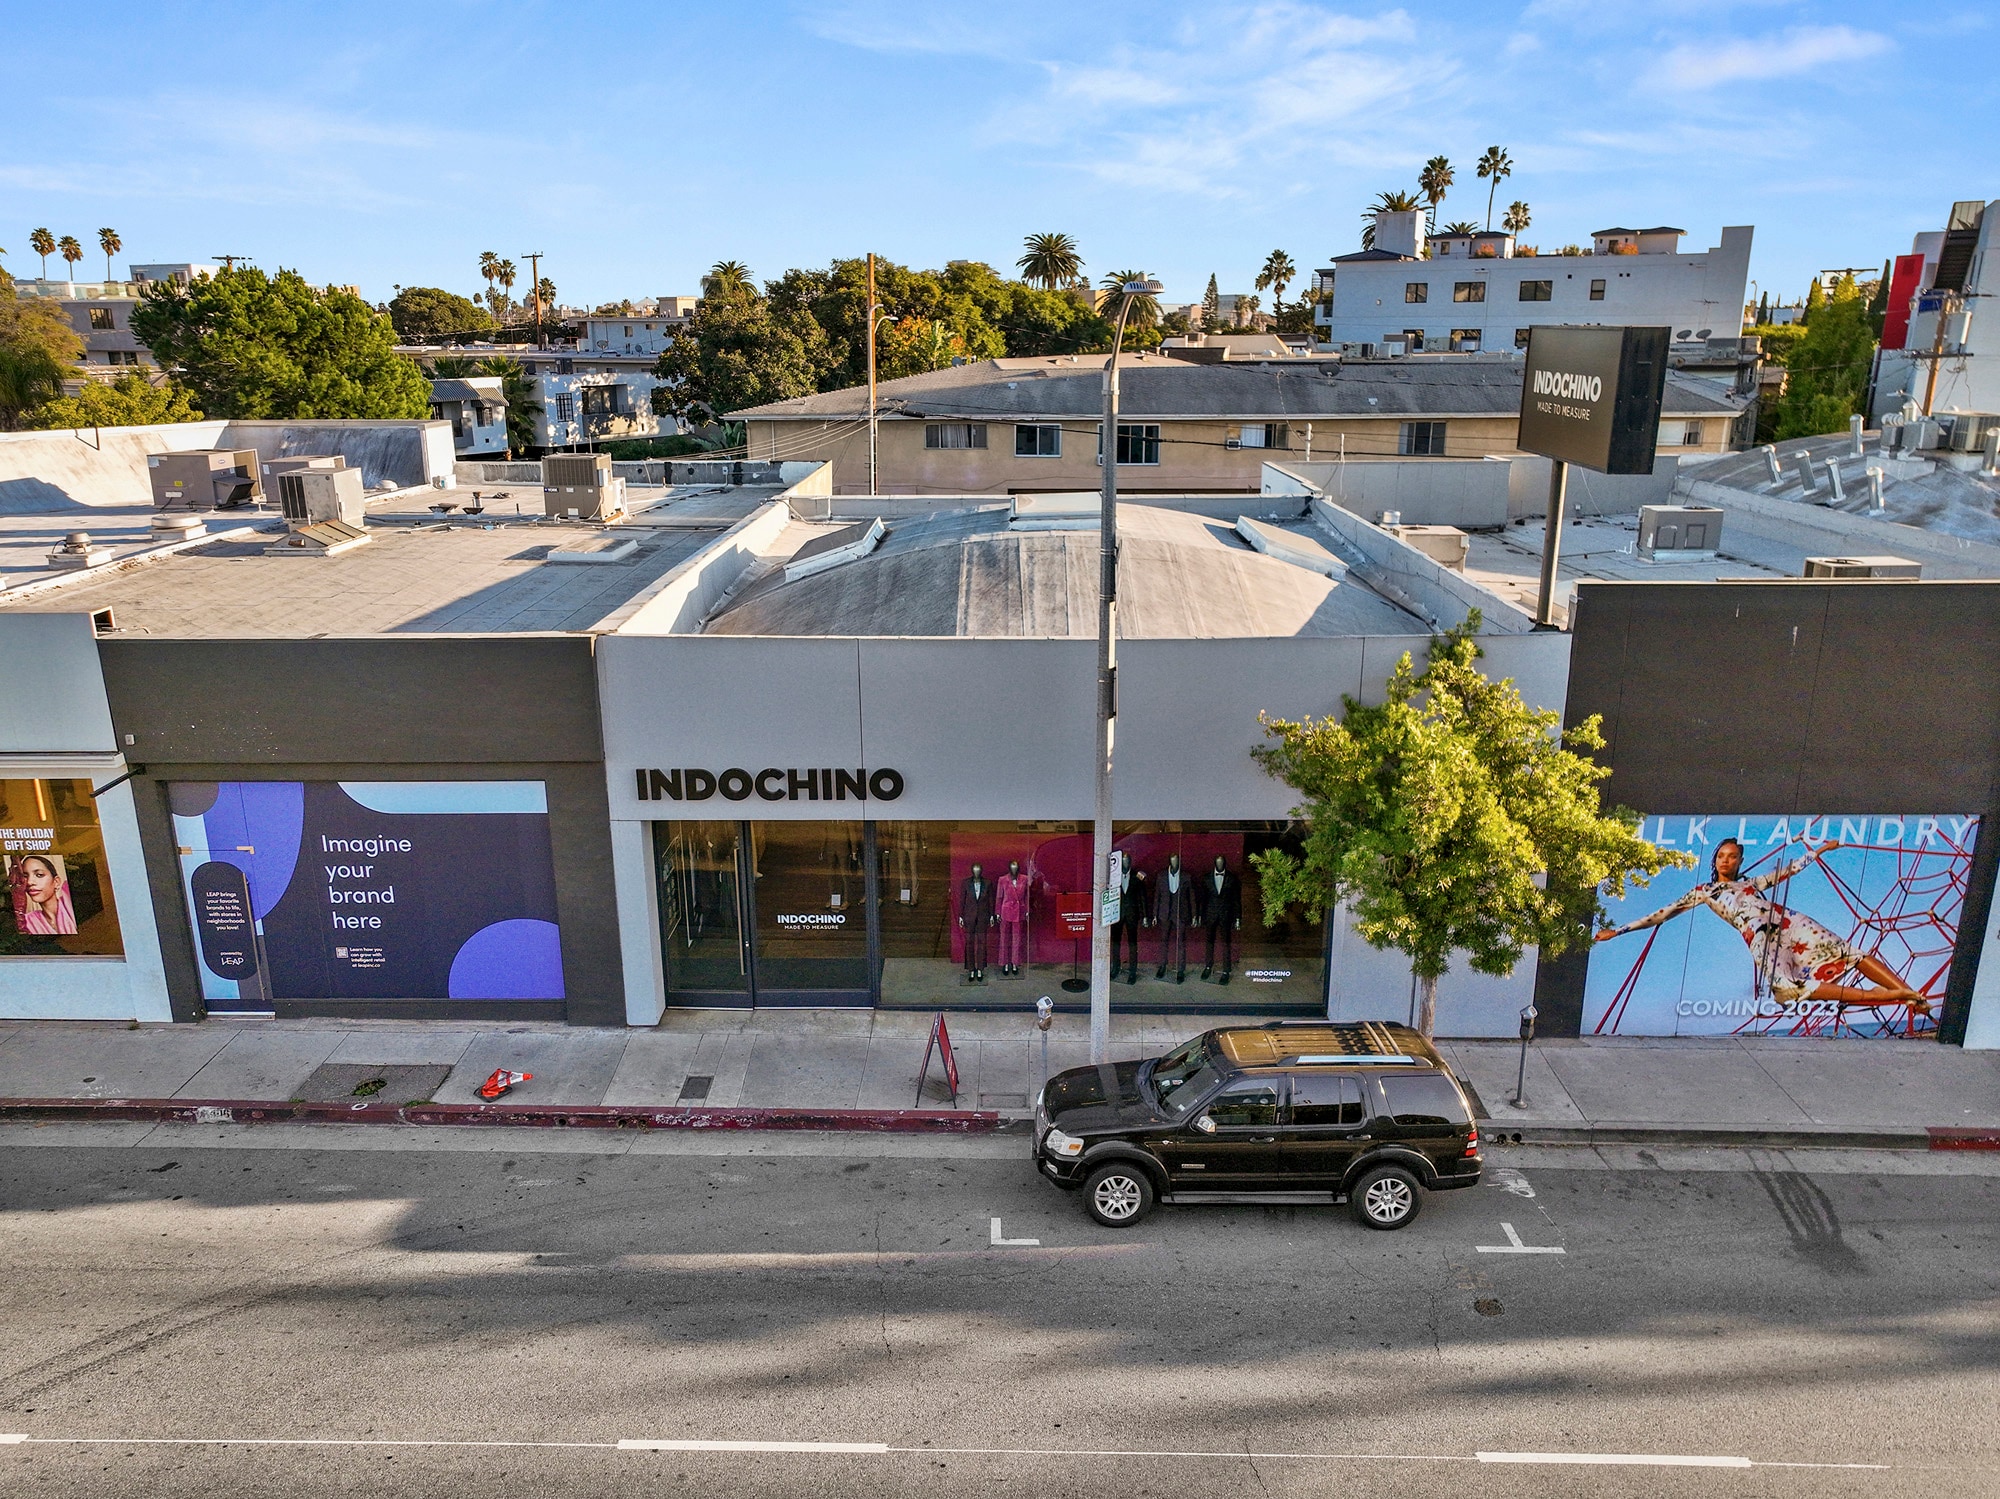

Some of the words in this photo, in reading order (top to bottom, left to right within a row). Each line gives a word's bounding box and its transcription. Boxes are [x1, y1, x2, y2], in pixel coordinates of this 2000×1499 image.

[1534, 370, 1602, 402] INDOCHINO
[1537, 401, 1552, 413] MADE
[1554, 403, 1561, 415] TO
[1562, 405, 1590, 421] MEASURE
[635, 768, 904, 801] INDOCHINO
[16, 828, 54, 839] HOLIDAY
[1637, 817, 1712, 845] ILK
[1737, 816, 1973, 846] LAUNDRY
[4, 840, 25, 850] GIFT
[25, 840, 51, 850] SHOP
[322, 834, 412, 857] Imagine
[324, 865, 374, 883] your
[328, 885, 395, 904] brand
[332, 911, 382, 929] here
[777, 914, 846, 924] INDOCHINO
[221, 957, 244, 966] LEAP
[1677, 999, 1777, 1016] COMING
[1783, 999, 1840, 1016] 2023
